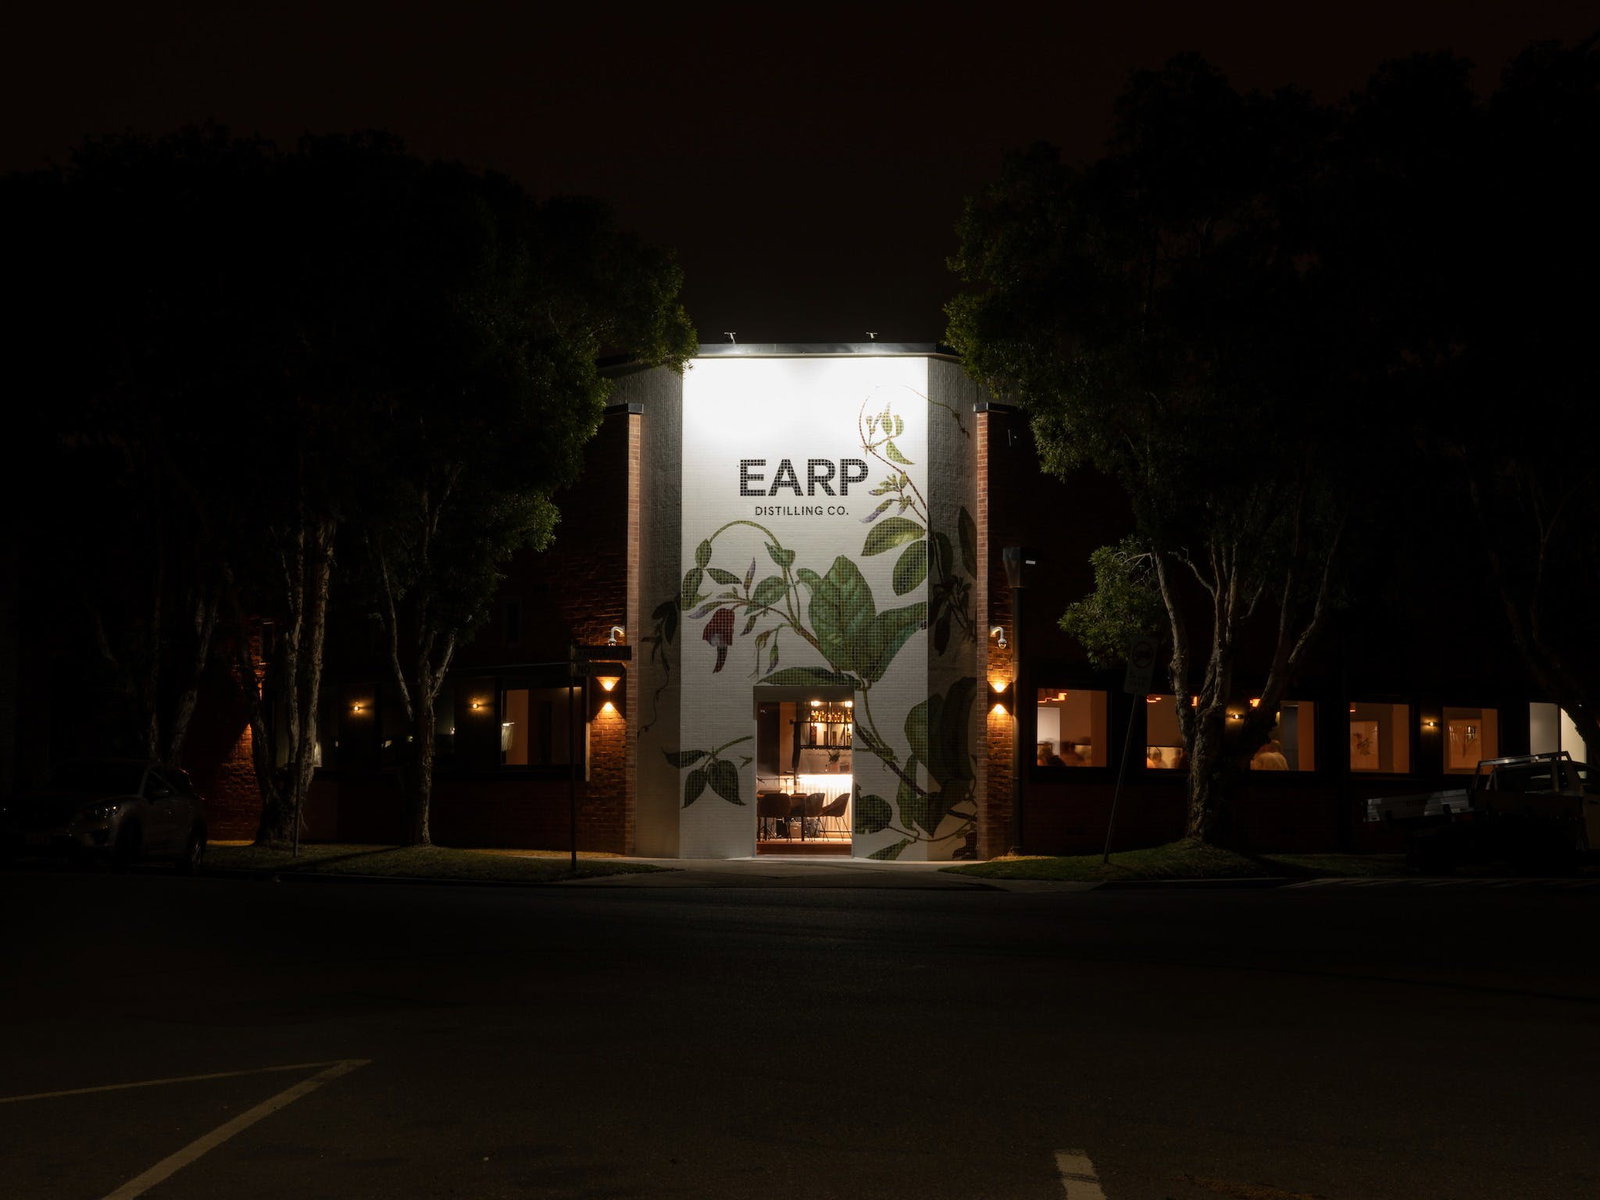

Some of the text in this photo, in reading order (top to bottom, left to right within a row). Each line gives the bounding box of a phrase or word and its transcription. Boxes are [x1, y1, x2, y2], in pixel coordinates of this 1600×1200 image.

[740, 459, 869, 496] EARP
[755, 506, 849, 516] DISTILLING CO.
